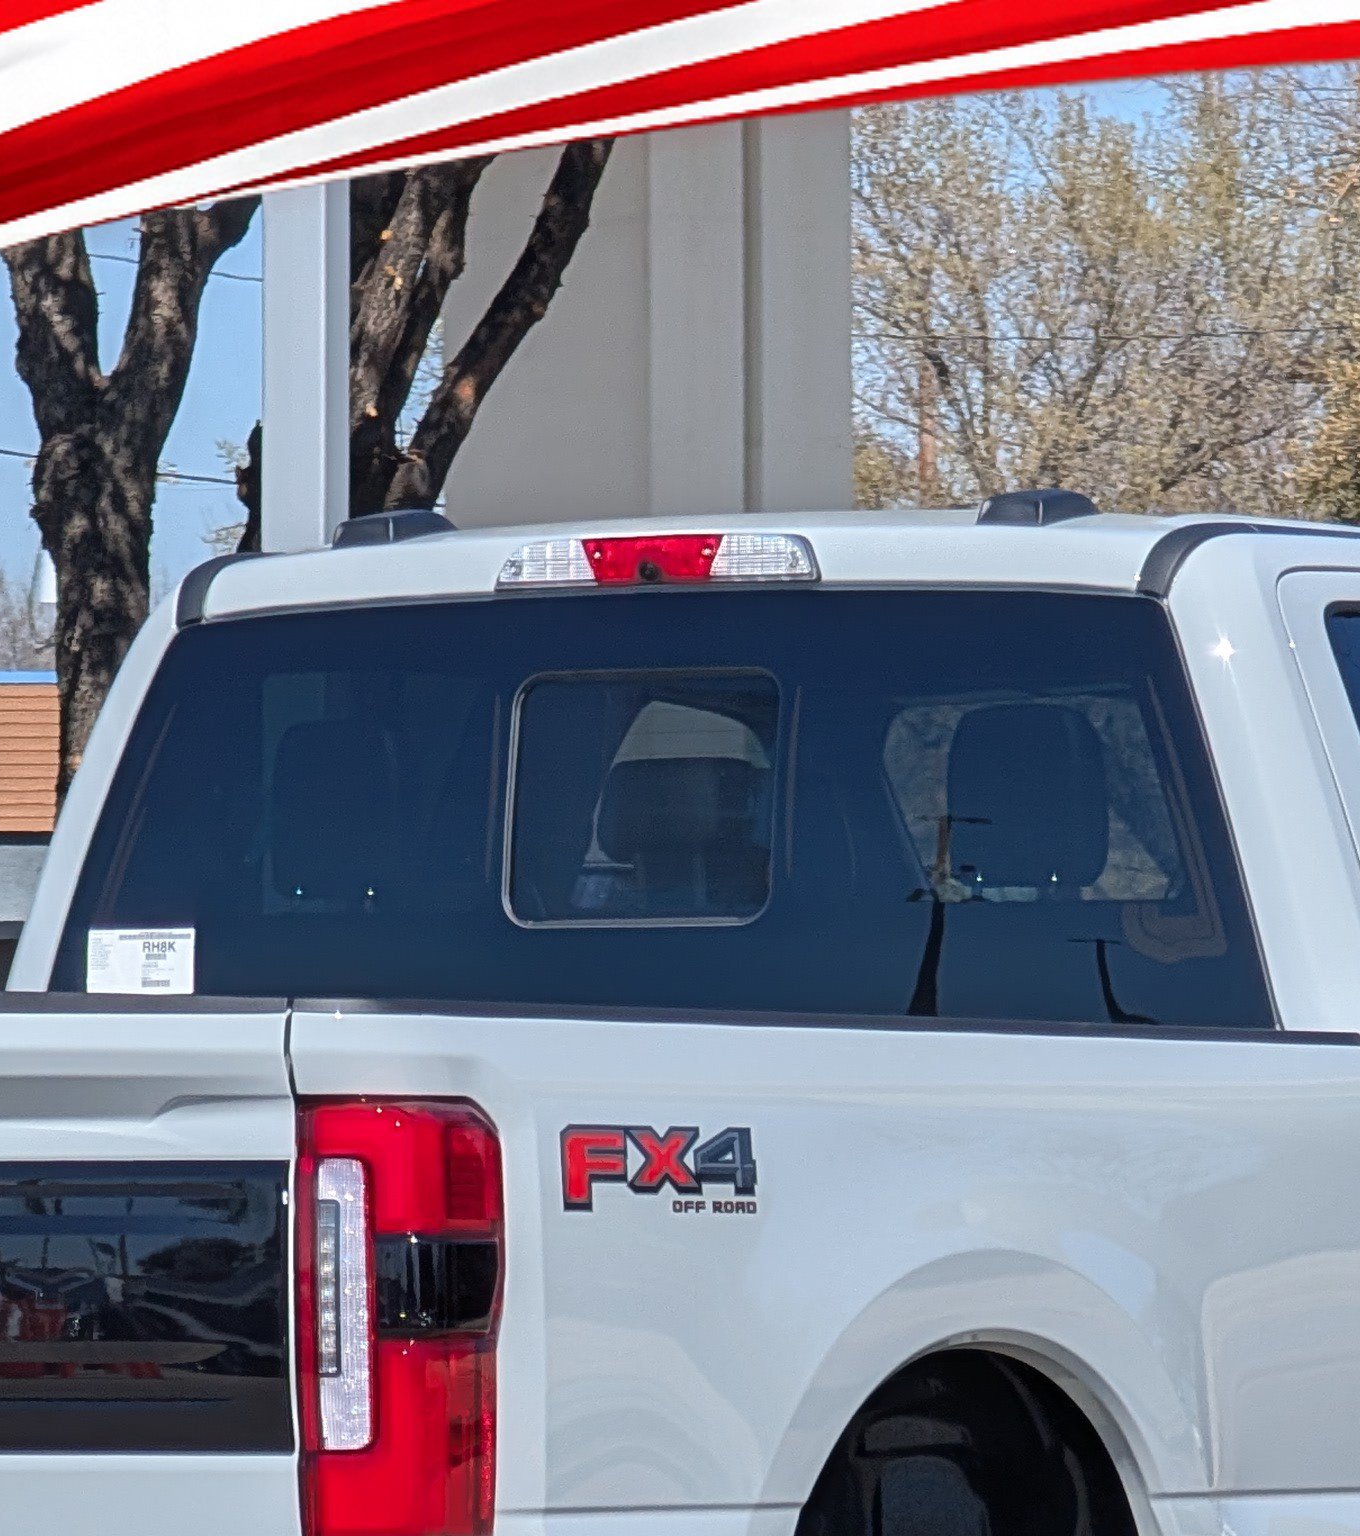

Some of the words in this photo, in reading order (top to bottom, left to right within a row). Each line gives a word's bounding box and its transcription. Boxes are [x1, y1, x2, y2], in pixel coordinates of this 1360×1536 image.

[560, 1124, 757, 1212] FX4
[672, 1200, 707, 1214] OFF
[712, 1200, 758, 1214] ROAD
